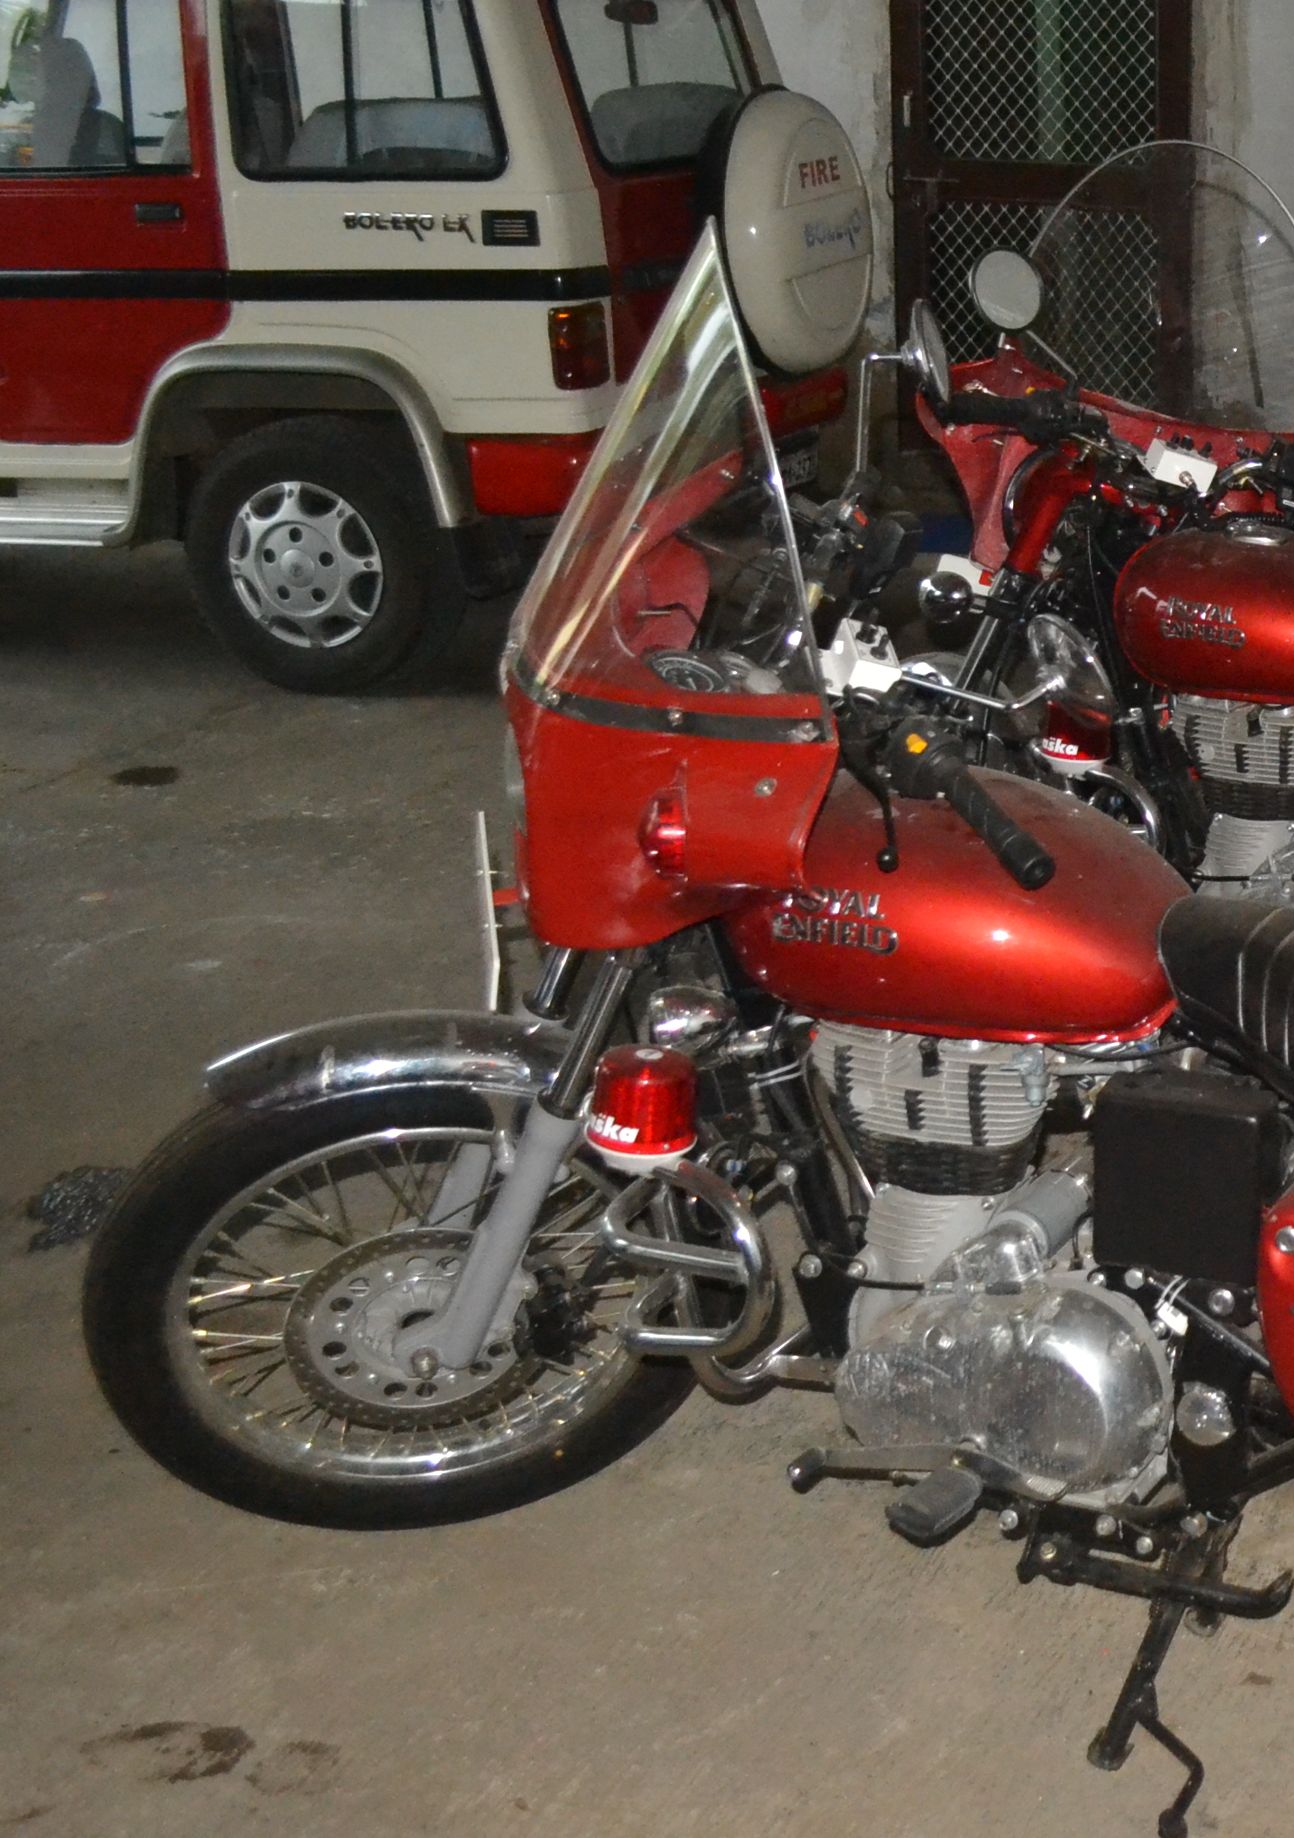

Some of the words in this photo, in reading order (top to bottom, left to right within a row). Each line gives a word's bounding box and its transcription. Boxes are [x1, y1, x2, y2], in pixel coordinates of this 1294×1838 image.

[798, 156, 840, 189] FIRE
[343, 212, 435, 242] BOLERO
[1167, 596, 1237, 624] ROYAL
[1160, 618, 1246, 650] ENFIELD
[772, 912, 899, 956] ENFIELD
